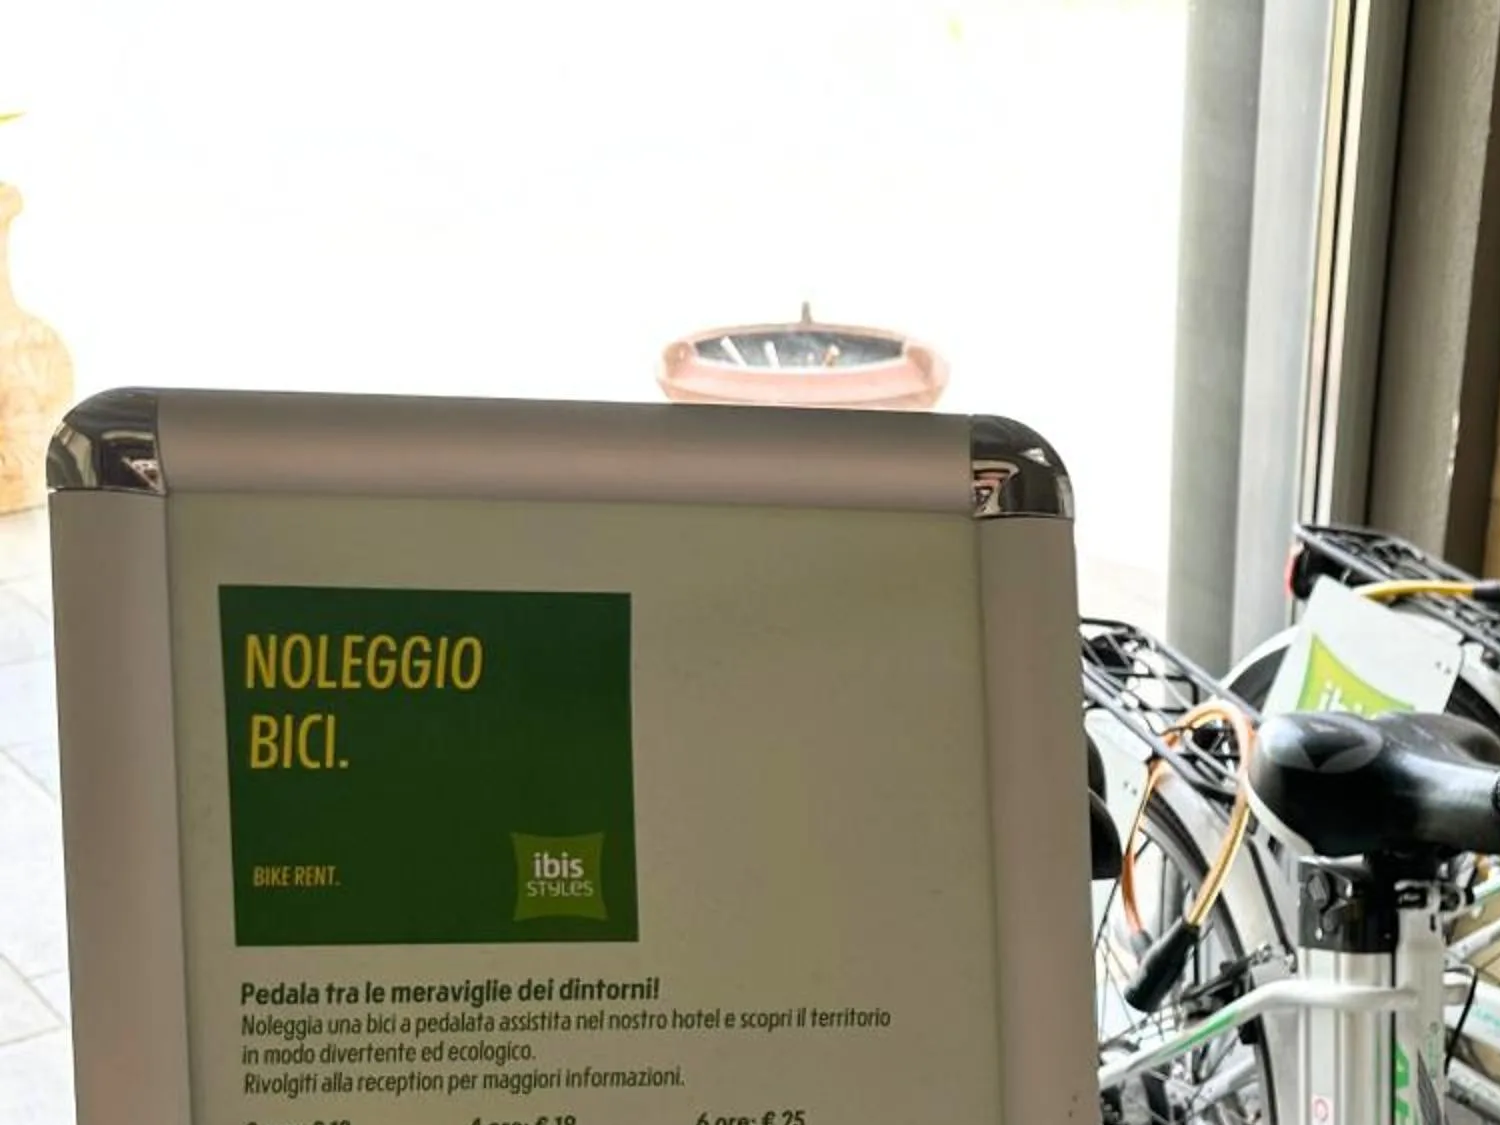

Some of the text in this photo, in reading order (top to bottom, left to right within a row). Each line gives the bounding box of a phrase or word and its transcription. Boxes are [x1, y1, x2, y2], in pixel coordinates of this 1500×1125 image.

[244, 633, 483, 689] NOLEGGIO
[250, 714, 350, 769] BICI.
[253, 865, 340, 887] BIKE RENT.
[533, 851, 583, 878] ibis
[240, 977, 660, 1008] Pedala tra le meraviglie dei dintorni!
[241, 1008, 891, 1041] Noleggia una bici pedalata assistita nel nostro hotel scopri territorio
[263, 1040, 536, 1066] modo divertente ed ecologico.
[244, 1065, 685, 1099] Rivolgiti alla reception per maggiori informazioni.
